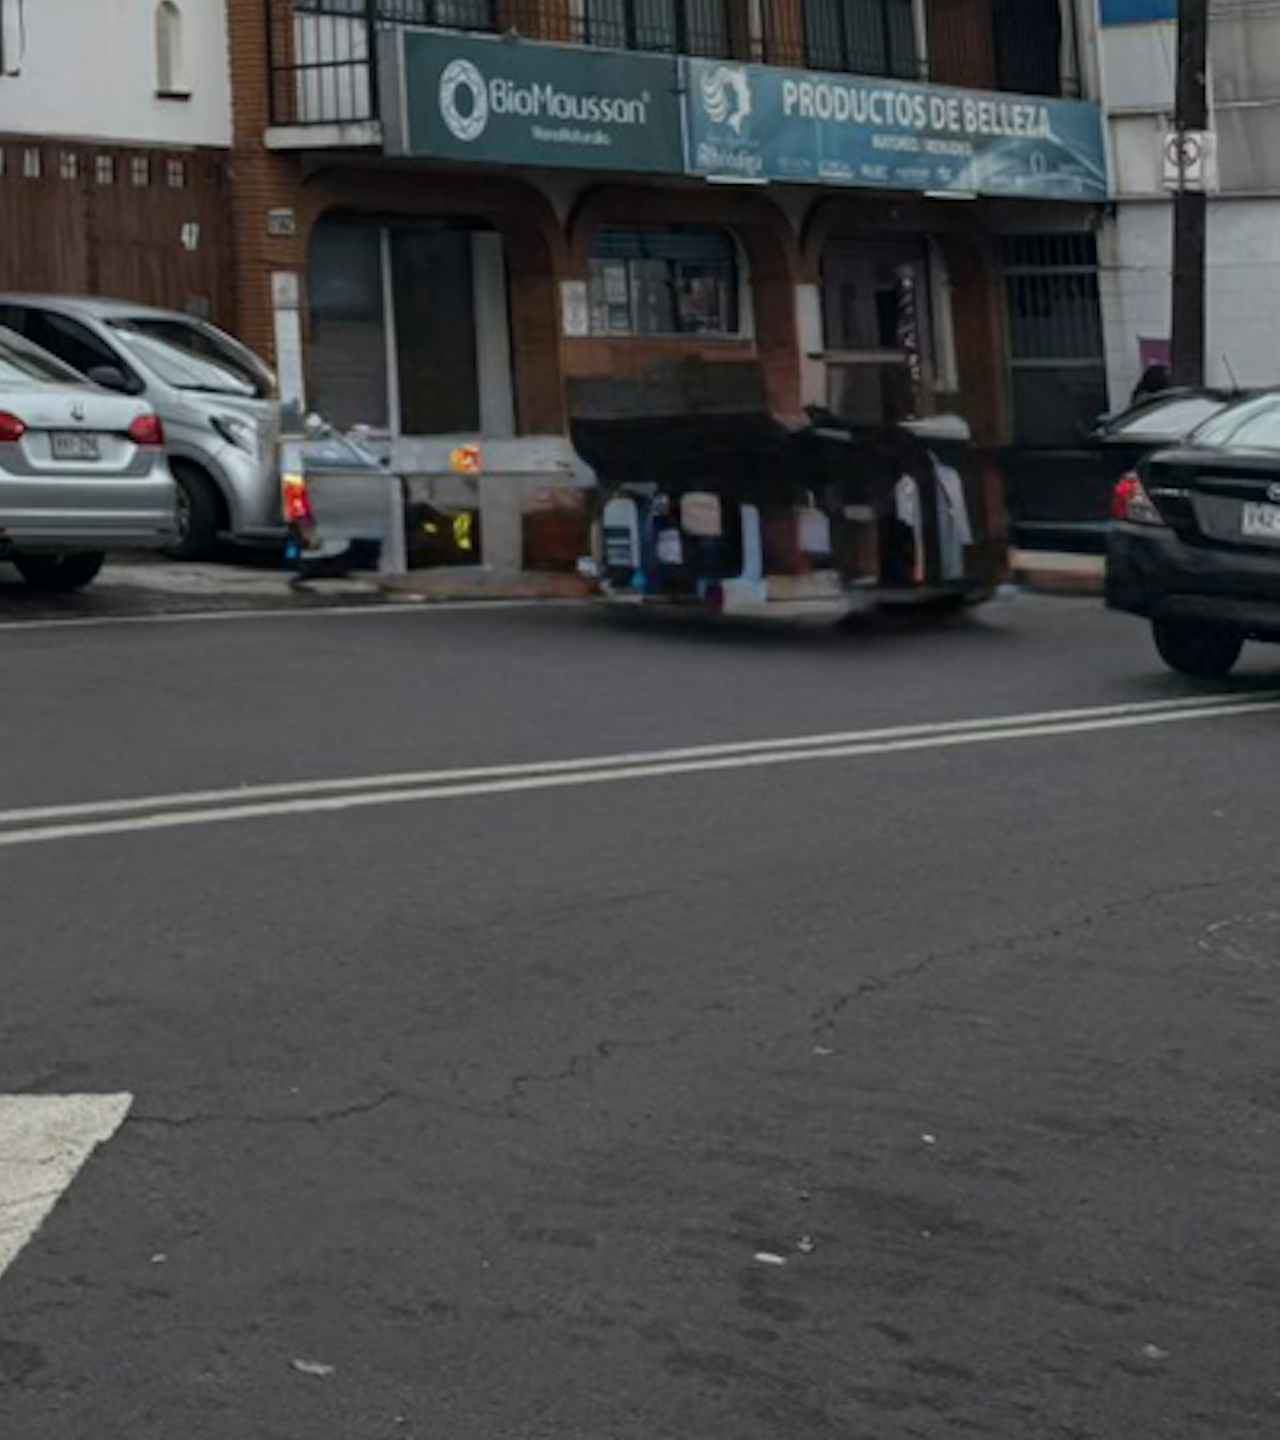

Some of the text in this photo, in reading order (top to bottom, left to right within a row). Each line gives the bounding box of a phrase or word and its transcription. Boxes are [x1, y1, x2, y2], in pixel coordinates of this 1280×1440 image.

[782, 79, 1053, 138] PRODUCTOS DE BELLEZA
